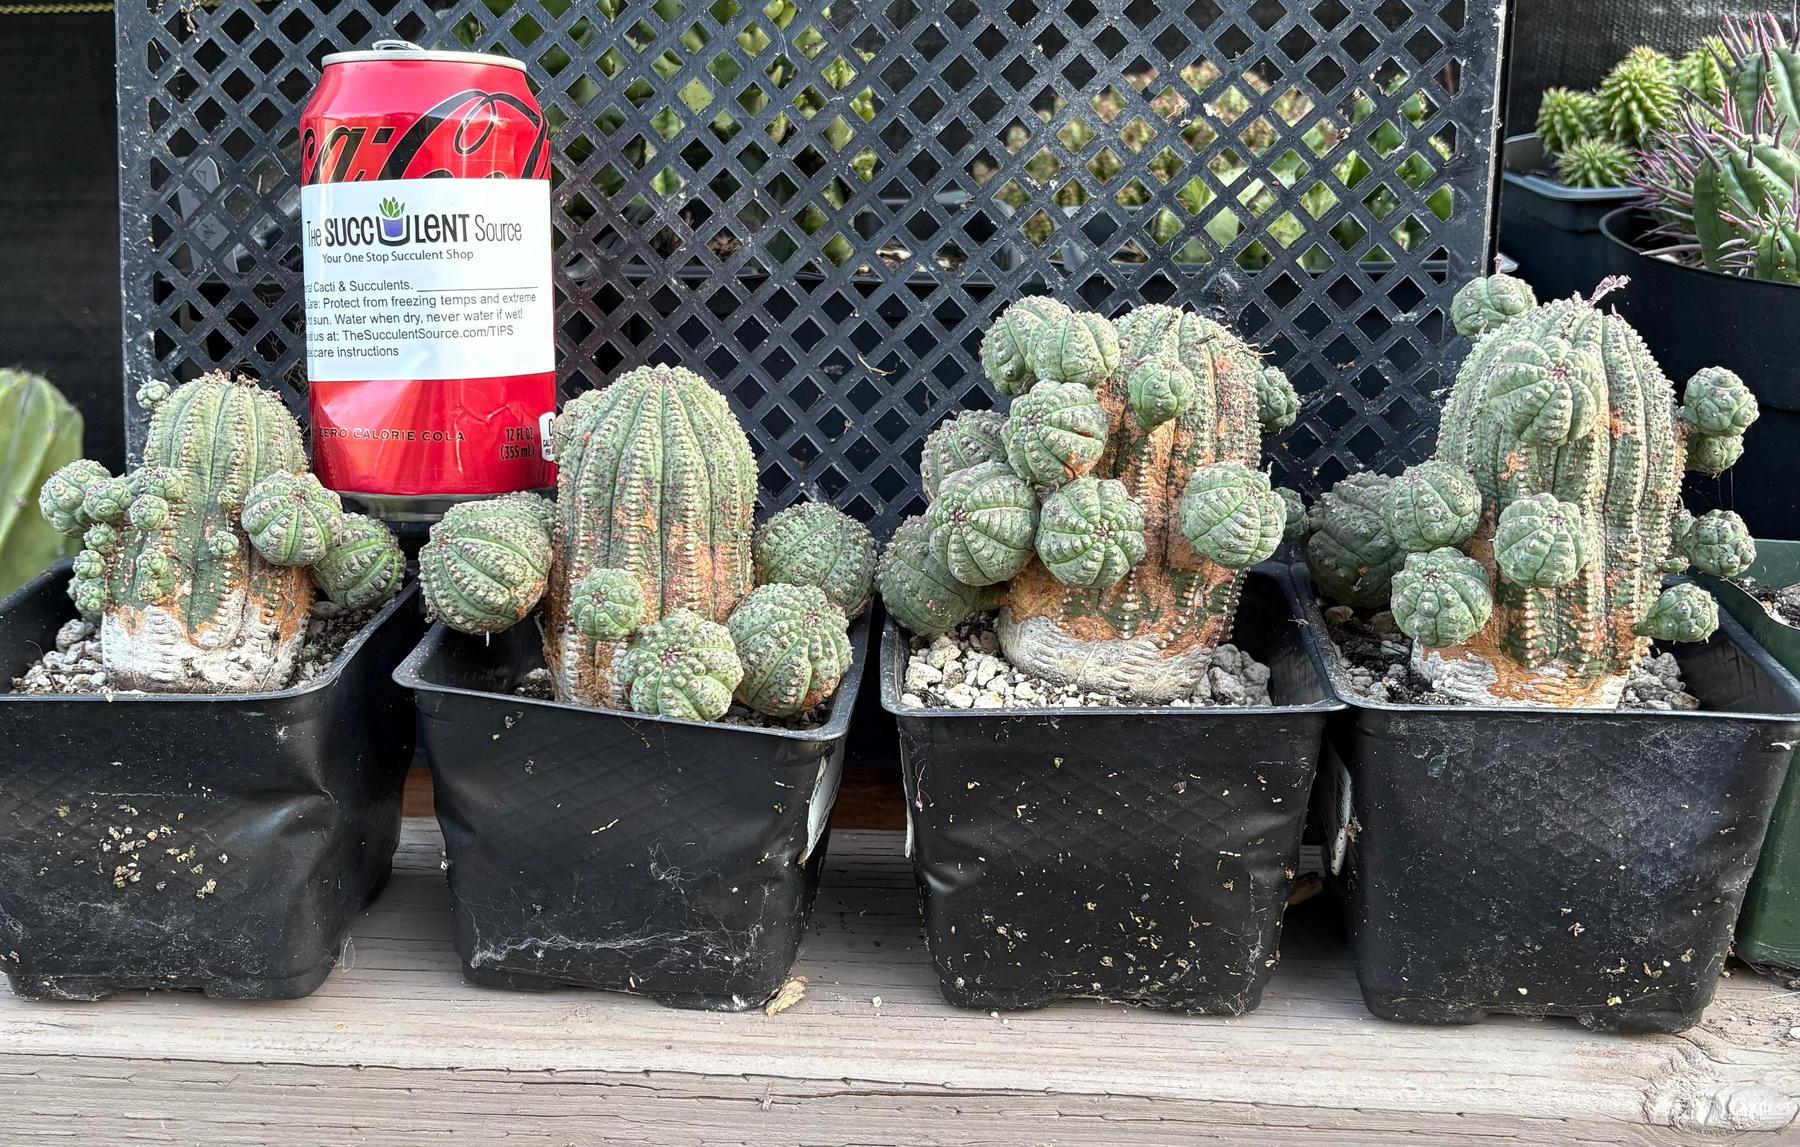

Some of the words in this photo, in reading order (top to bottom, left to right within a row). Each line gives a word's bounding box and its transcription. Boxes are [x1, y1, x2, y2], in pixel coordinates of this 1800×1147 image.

[474, 214, 522, 242] Source
[322, 253, 342, 264] Your
[343, 252, 364, 263] One
[366, 251, 389, 264] Stop
[391, 250, 444, 261] Succulent
[446, 249, 474, 262] Shop
[313, 281, 336, 293] Cacti
[338, 280, 347, 292] &
[349, 279, 414, 292] Succulents.
[323, 298, 361, 309] Protect
[363, 296, 388, 308] from
[391, 295, 437, 309] freezing
[440, 295, 477, 308] temps
[480, 293, 500, 304] and
[502, 293, 537, 304] extreme
[313, 316, 332, 326] sun.
[334, 314, 367, 325] Water
[369, 313, 401, 324] when
[403, 312, 424, 326] dry,
[426, 312, 460, 323] never
[463, 311, 494, 322] water
[496, 309, 503, 320] if
[504, 308, 524, 320] wet!
[313, 333, 325, 342] us
[326, 331, 340, 342] at:
[342, 325, 514, 341] TheSucculentSource.com/TIPS
[313, 349, 335, 358] care
[336, 346, 400, 358] instructions
[319, 427, 348, 439] ZERO
[353, 429, 416, 442] CALORIE
[421, 430, 465, 442] COLA
[506, 427, 515, 442] 12
[516, 427, 525, 441] FL
[500, 444, 520, 460] (355
